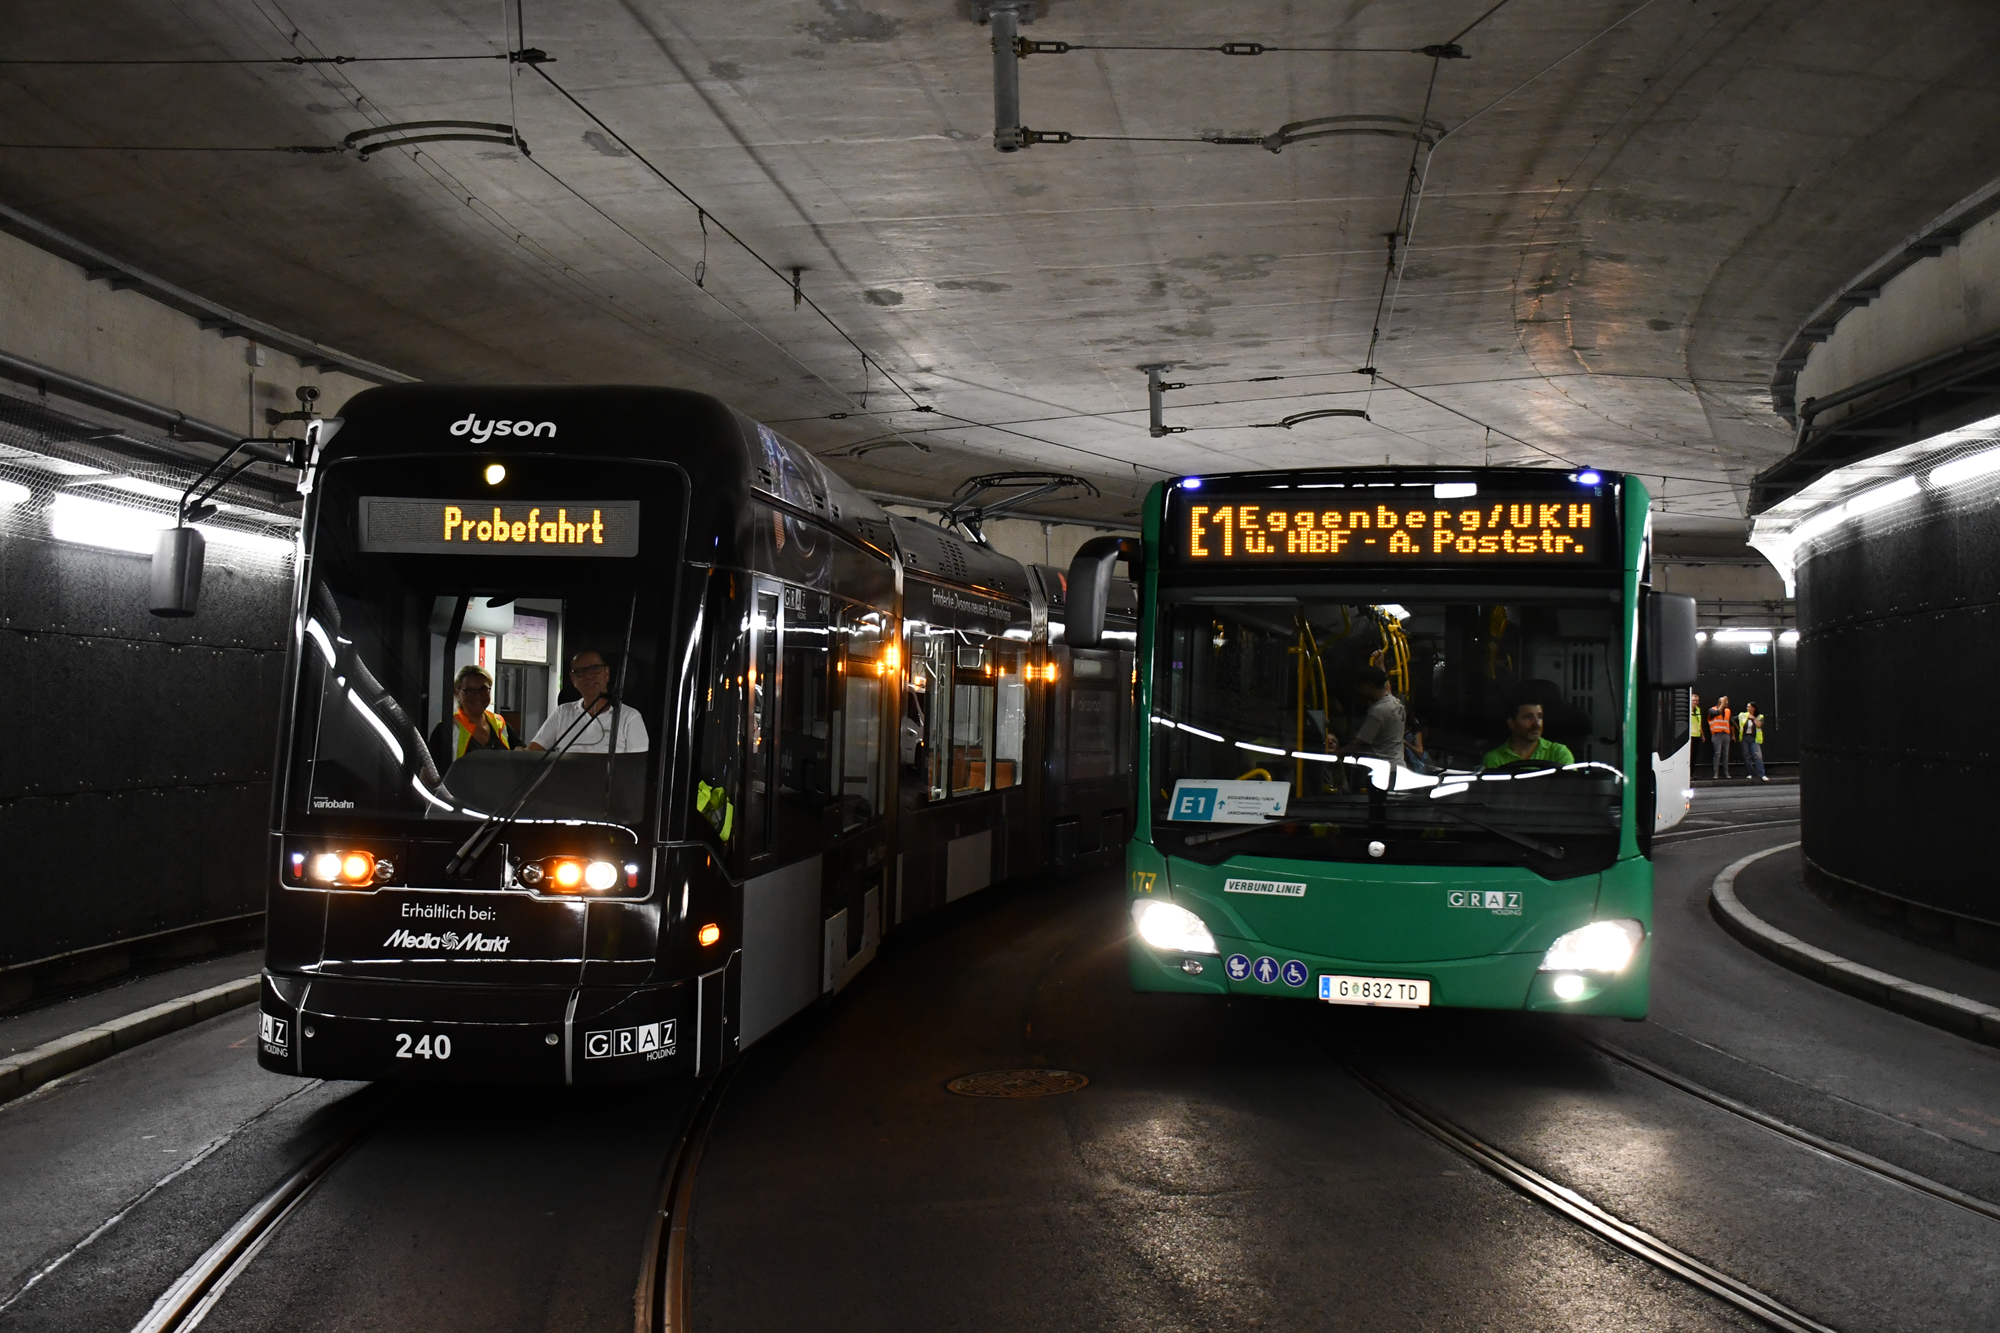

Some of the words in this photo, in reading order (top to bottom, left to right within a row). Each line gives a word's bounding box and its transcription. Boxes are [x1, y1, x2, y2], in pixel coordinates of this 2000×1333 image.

[450, 413, 557, 444] dyson
[444, 506, 604, 543] Probefahrt
[1239, 504, 1591, 532] Eggenberg/UKH
[1191, 506, 1232, 556] E1
[1246, 530, 1274, 553] ü.
[1288, 530, 1351, 553] HBF
[1389, 530, 1419, 553] A.
[1433, 529, 1584, 553] Poststr.
[784, 586, 806, 612] GRAZ
[932, 587, 954, 609] Entdecke
[988, 601, 1011, 624] Technologie
[313, 799, 355, 809] variobahn
[1180, 796, 1207, 814] E1
[1132, 870, 1158, 893] 177
[1228, 881, 1275, 893] VERBUND
[1276, 884, 1302, 895] LINIE
[401, 902, 467, 920] Erhältlich
[468, 904, 497, 921] bei:
[1447, 890, 1522, 910] GRAZ
[383, 929, 442, 950] Media
[455, 932, 511, 953] Markt
[1339, 980, 1349, 997] G
[1362, 982, 1393, 999] 832
[1398, 984, 1418, 1000] TD
[395, 1033, 452, 1060] 240
[585, 1018, 677, 1059] GRAZ
[646, 1046, 677, 1062] HOLDING
